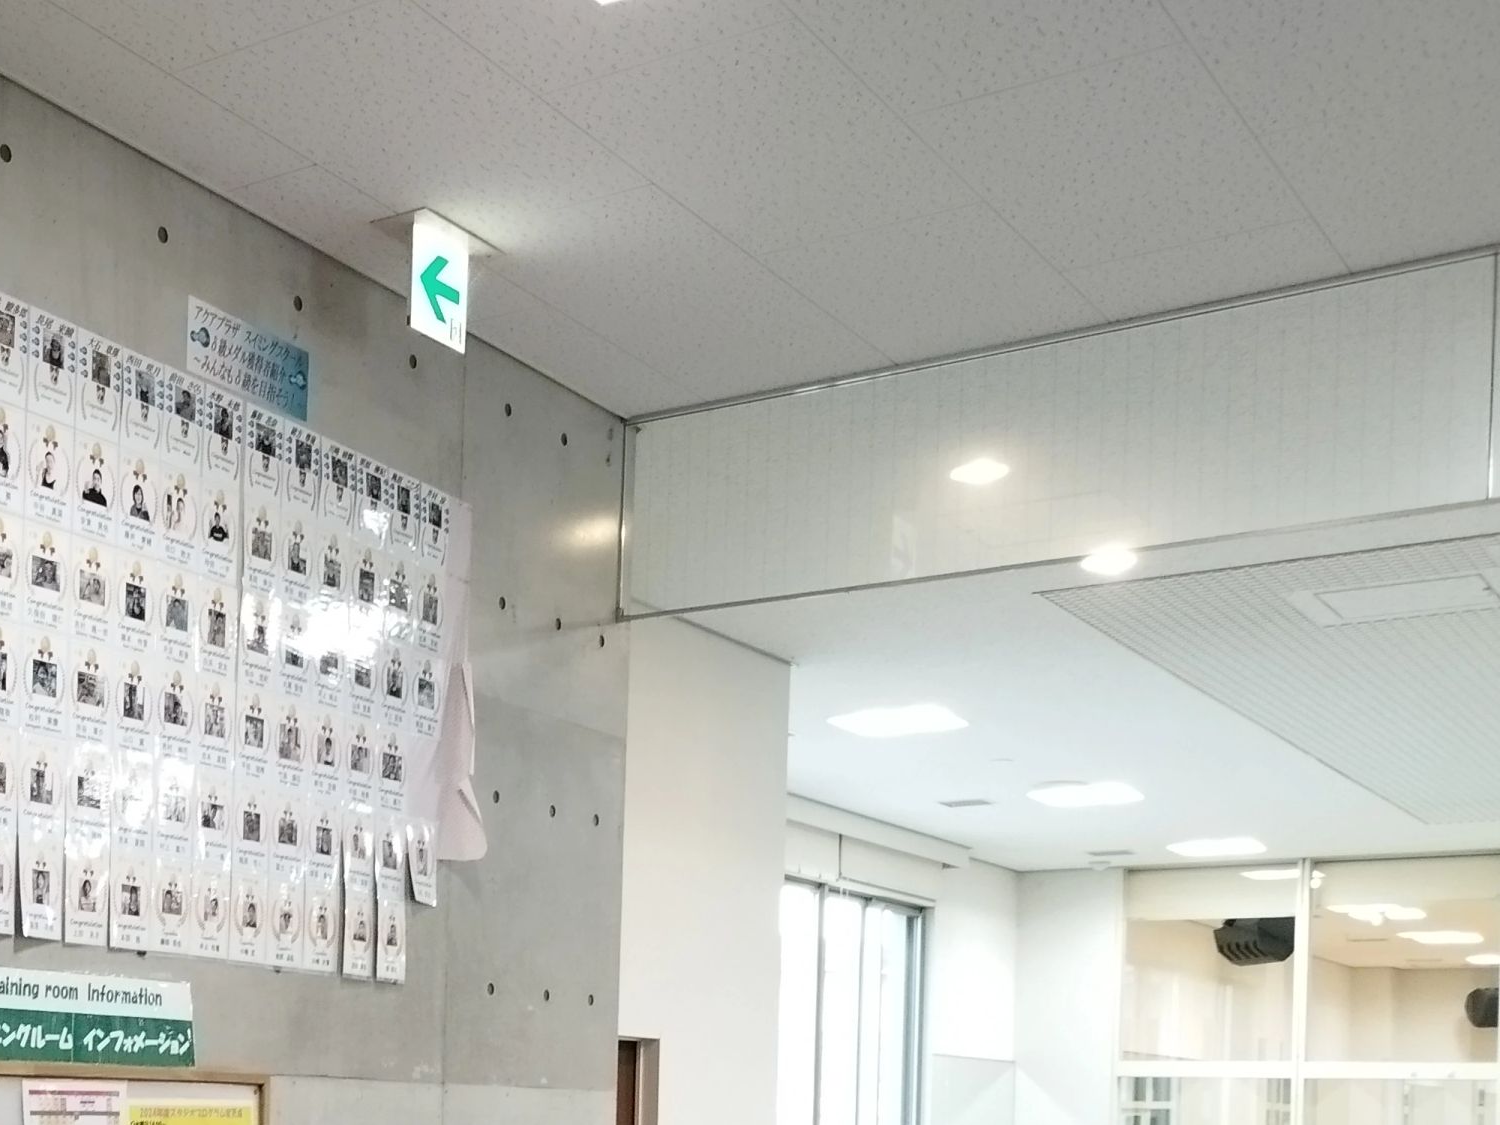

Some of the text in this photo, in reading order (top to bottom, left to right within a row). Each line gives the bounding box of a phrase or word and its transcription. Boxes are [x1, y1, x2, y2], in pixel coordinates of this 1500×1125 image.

[45, 983, 79, 1001] room
[83, 1027, 193, 1056] インフォメーション
